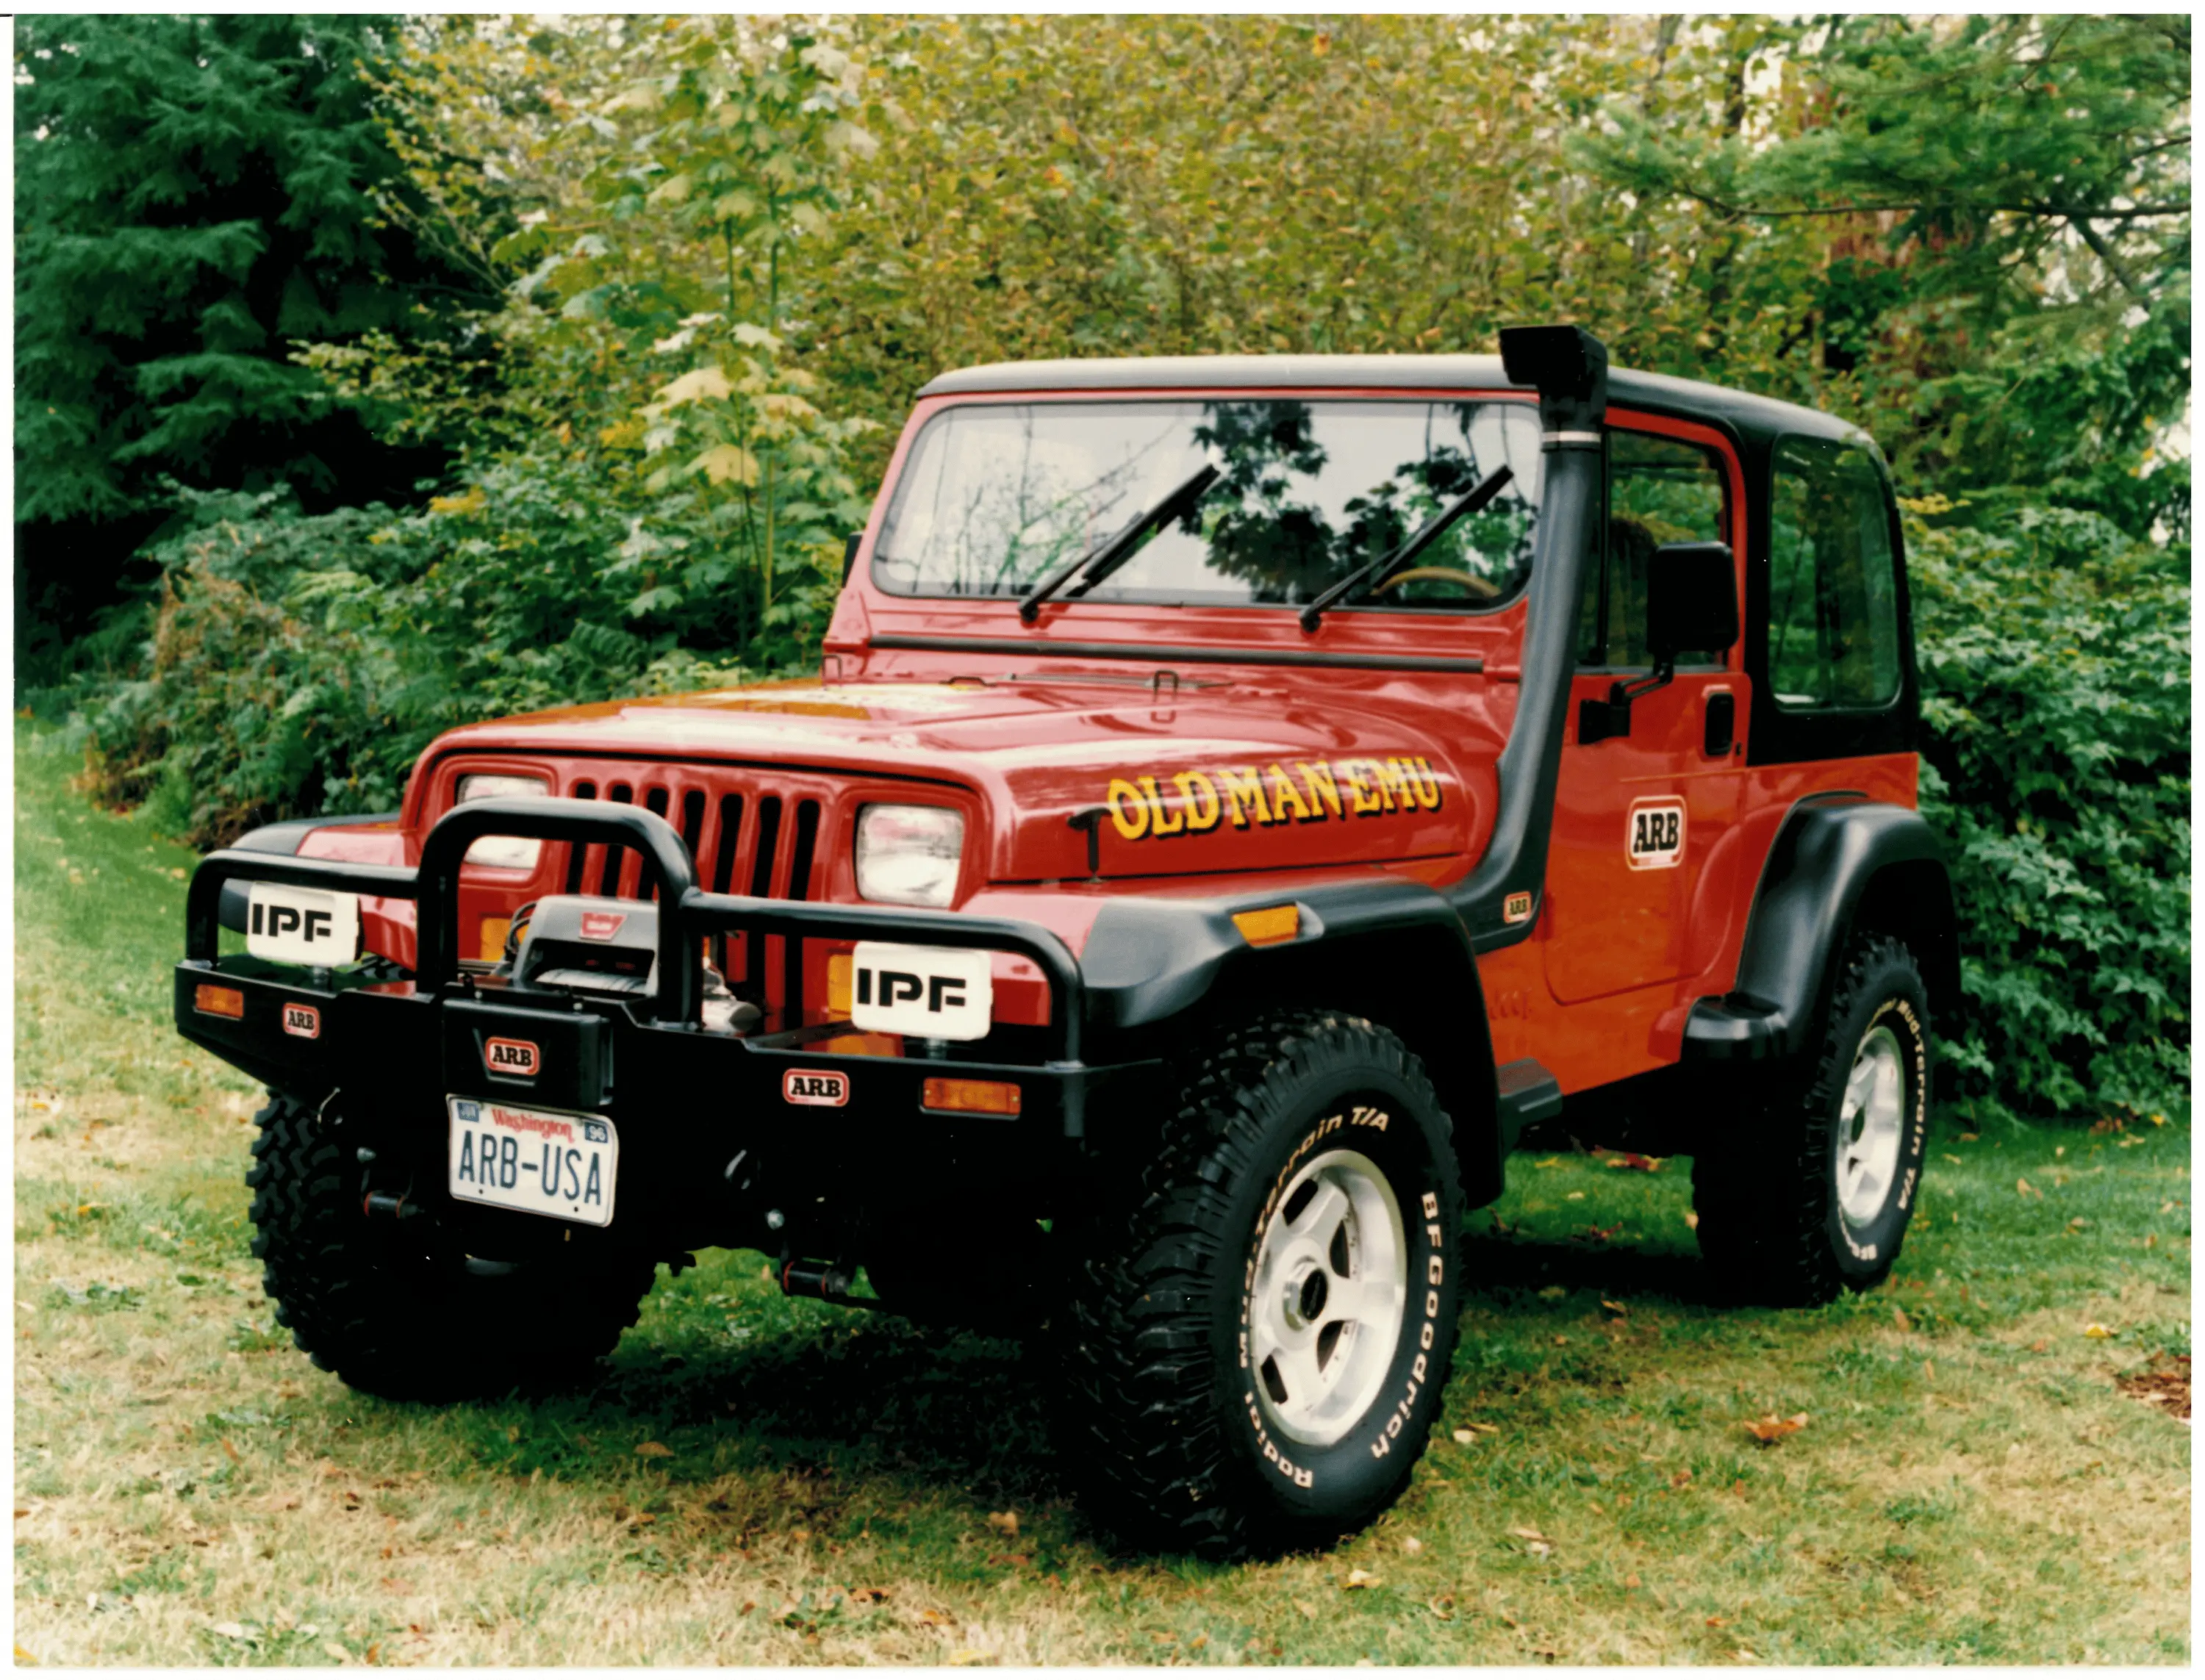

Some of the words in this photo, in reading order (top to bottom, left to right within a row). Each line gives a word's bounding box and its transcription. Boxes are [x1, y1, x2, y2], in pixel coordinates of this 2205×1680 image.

[1107, 770, 1222, 841] OLD
[1217, 760, 1343, 829] MAN
[1342, 755, 1442, 813] EMU
[1633, 811, 1679, 853] ARB
[251, 902, 333, 943] IPF
[1509, 899, 1527, 915] ARB
[857, 967, 967, 1013] IPF
[287, 1010, 315, 1030] ARB
[492, 1045, 532, 1066] ARB
[791, 1077, 841, 1097] ARB
[491, 1108, 575, 1144] Washington
[1351, 1107, 1390, 1132] T/A
[459, 1130, 601, 1205] ARB-USA
[1372, 1191, 1444, 1459] BFGoodrich
[1244, 1390, 1313, 1488] Radial
